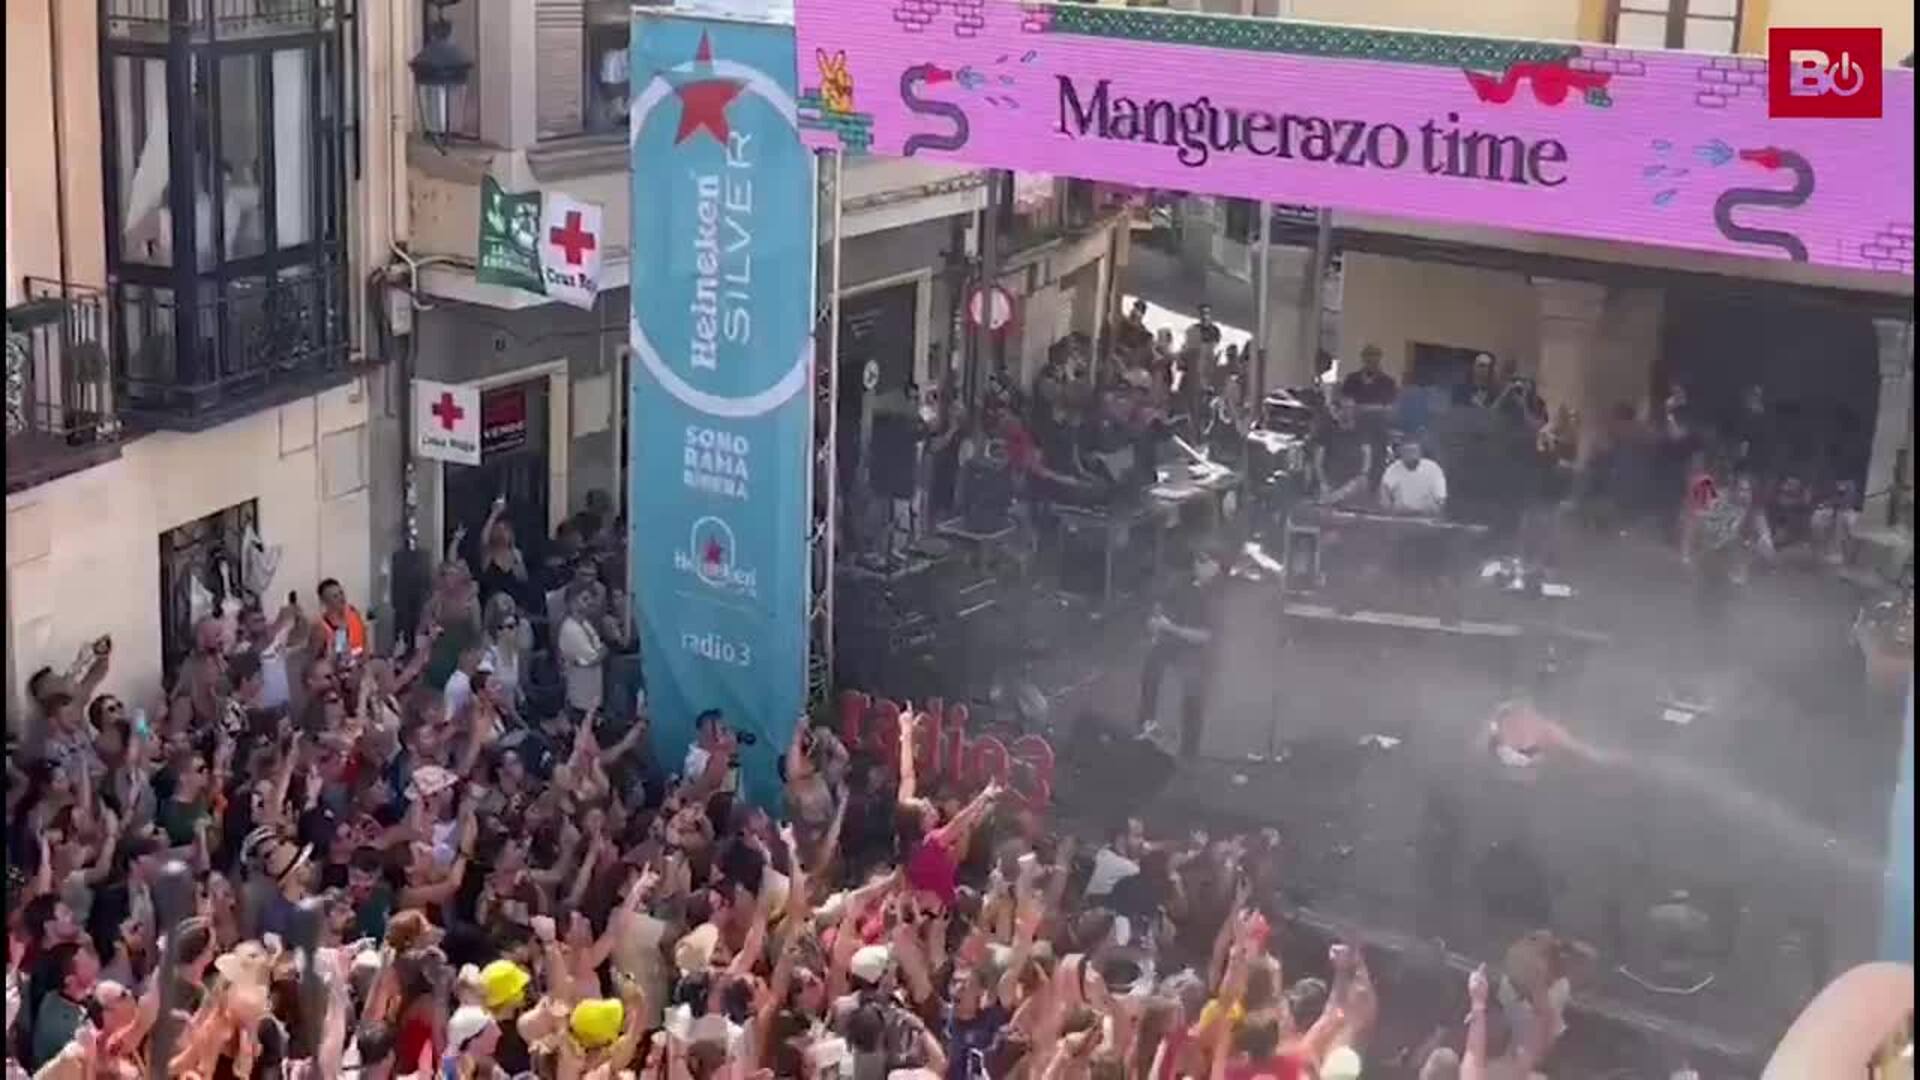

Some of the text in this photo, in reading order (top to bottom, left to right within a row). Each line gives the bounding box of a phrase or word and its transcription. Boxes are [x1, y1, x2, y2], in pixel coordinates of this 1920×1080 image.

[1055, 74, 1568, 187] Manguerazo time
[690, 174, 720, 372] Heineken
[723, 131, 754, 345] SILVER
[684, 447, 749, 481] RAMA
[685, 426, 749, 455] SONO
